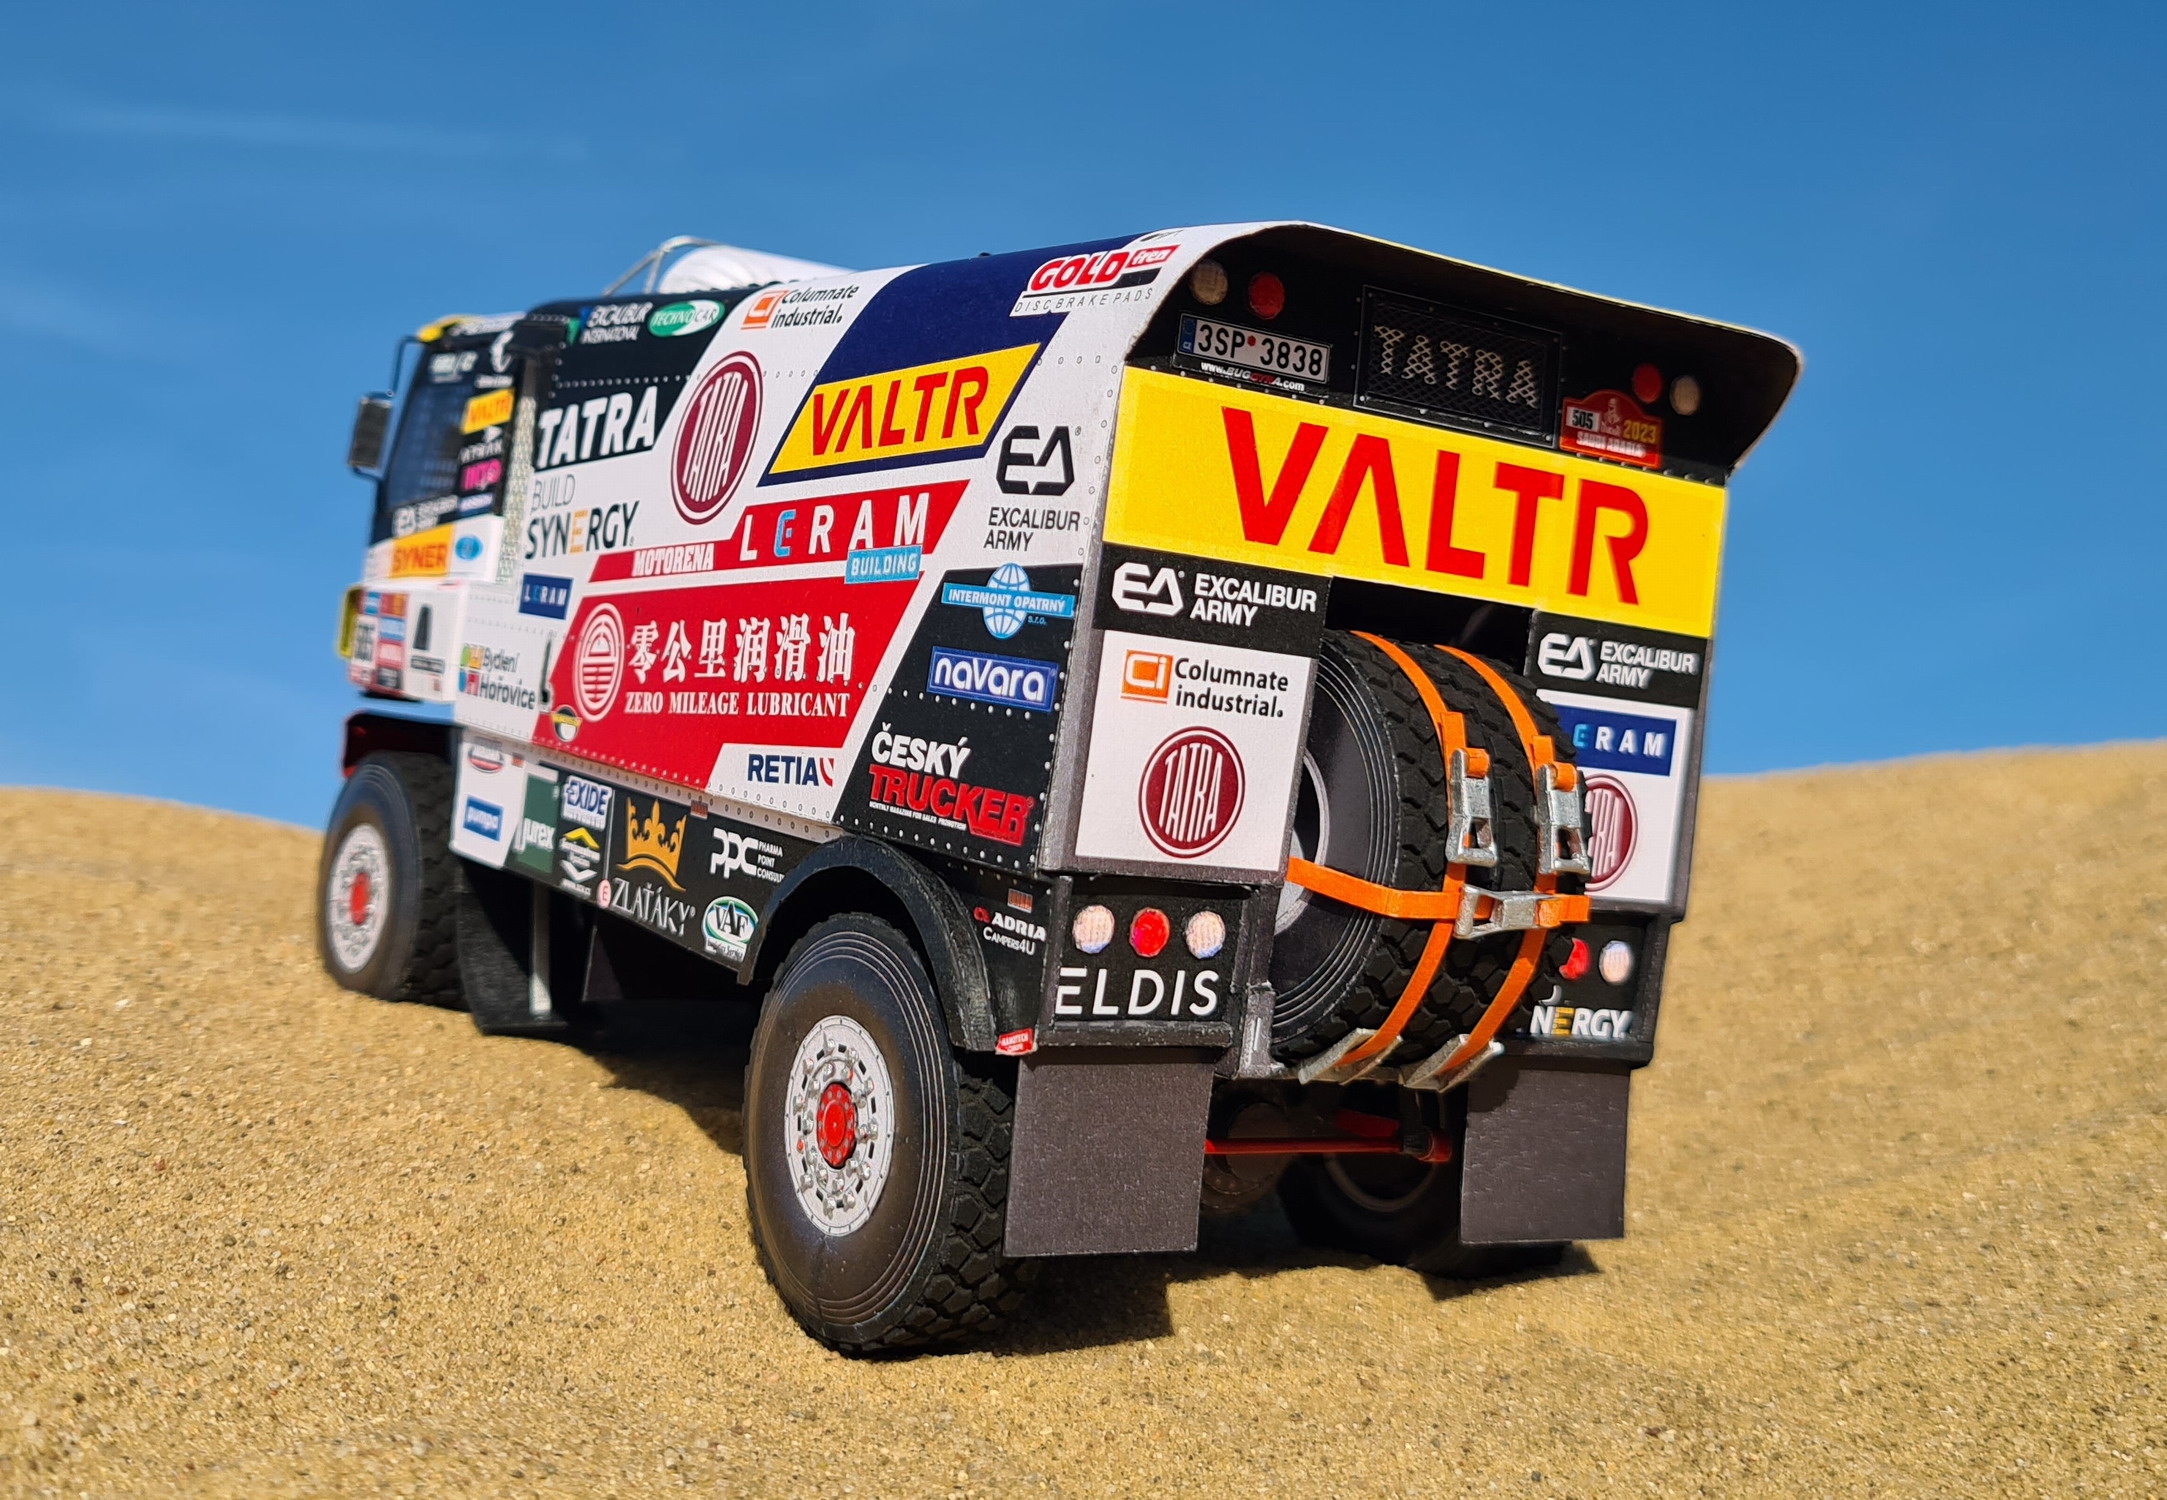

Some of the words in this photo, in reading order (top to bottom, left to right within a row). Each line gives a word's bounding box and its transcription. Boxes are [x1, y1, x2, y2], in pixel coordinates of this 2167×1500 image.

[1030, 252, 1130, 292] GOLD
[782, 284, 860, 305] Columnate
[1014, 297, 1052, 314] DISC
[1055, 292, 1109, 310] BRAKE
[1112, 287, 1154, 305] PADS
[771, 303, 843, 330] industrial.
[1198, 323, 1246, 359] 3SP
[1259, 337, 1323, 377] 3838
[1373, 324, 1540, 409] TATRA
[538, 386, 659, 467] TATRA
[812, 366, 990, 456] VALTR
[1571, 409, 1595, 431] 505
[1622, 419, 1657, 444] 2023
[530, 473, 576, 512] BUILD
[1221, 405, 1649, 607] VALTR
[524, 500, 641, 561] SYNERGY
[740, 491, 931, 562] LERAM
[988, 506, 1081, 532] EXCALIBUR
[983, 529, 1034, 552] ARMY
[631, 543, 715, 577] MOTORENA
[850, 553, 918, 578] BUILDING
[948, 588, 1013, 607] INTERMONT
[1193, 572, 1318, 613] EXCALIBUR
[1189, 598, 1258, 627] ARMY
[627, 612, 856, 685] 零公里润滑油
[1599, 640, 1698, 675] EXCALIBUR
[1174, 657, 1289, 692] Columnate
[1595, 662, 1650, 689] ARMY
[624, 691, 664, 715] ZERO
[667, 692, 740, 716] MILEAGE
[746, 692, 850, 718] LUBRICANT
[1174, 684, 1285, 718] industrial.
[871, 722, 972, 780] ČESKÝ
[1572, 722, 1667, 758] ERAM
[746, 753, 820, 787] RETIA
[566, 780, 609, 816] EXIDE
[868, 764, 1030, 846] TRUCKER
[757, 854, 776, 868] POINT
[758, 841, 784, 857] PHARMA
[713, 900, 749, 938] VAF
[991, 911, 1048, 942] ADRIA
[1054, 966, 1220, 1016] ELDIS
